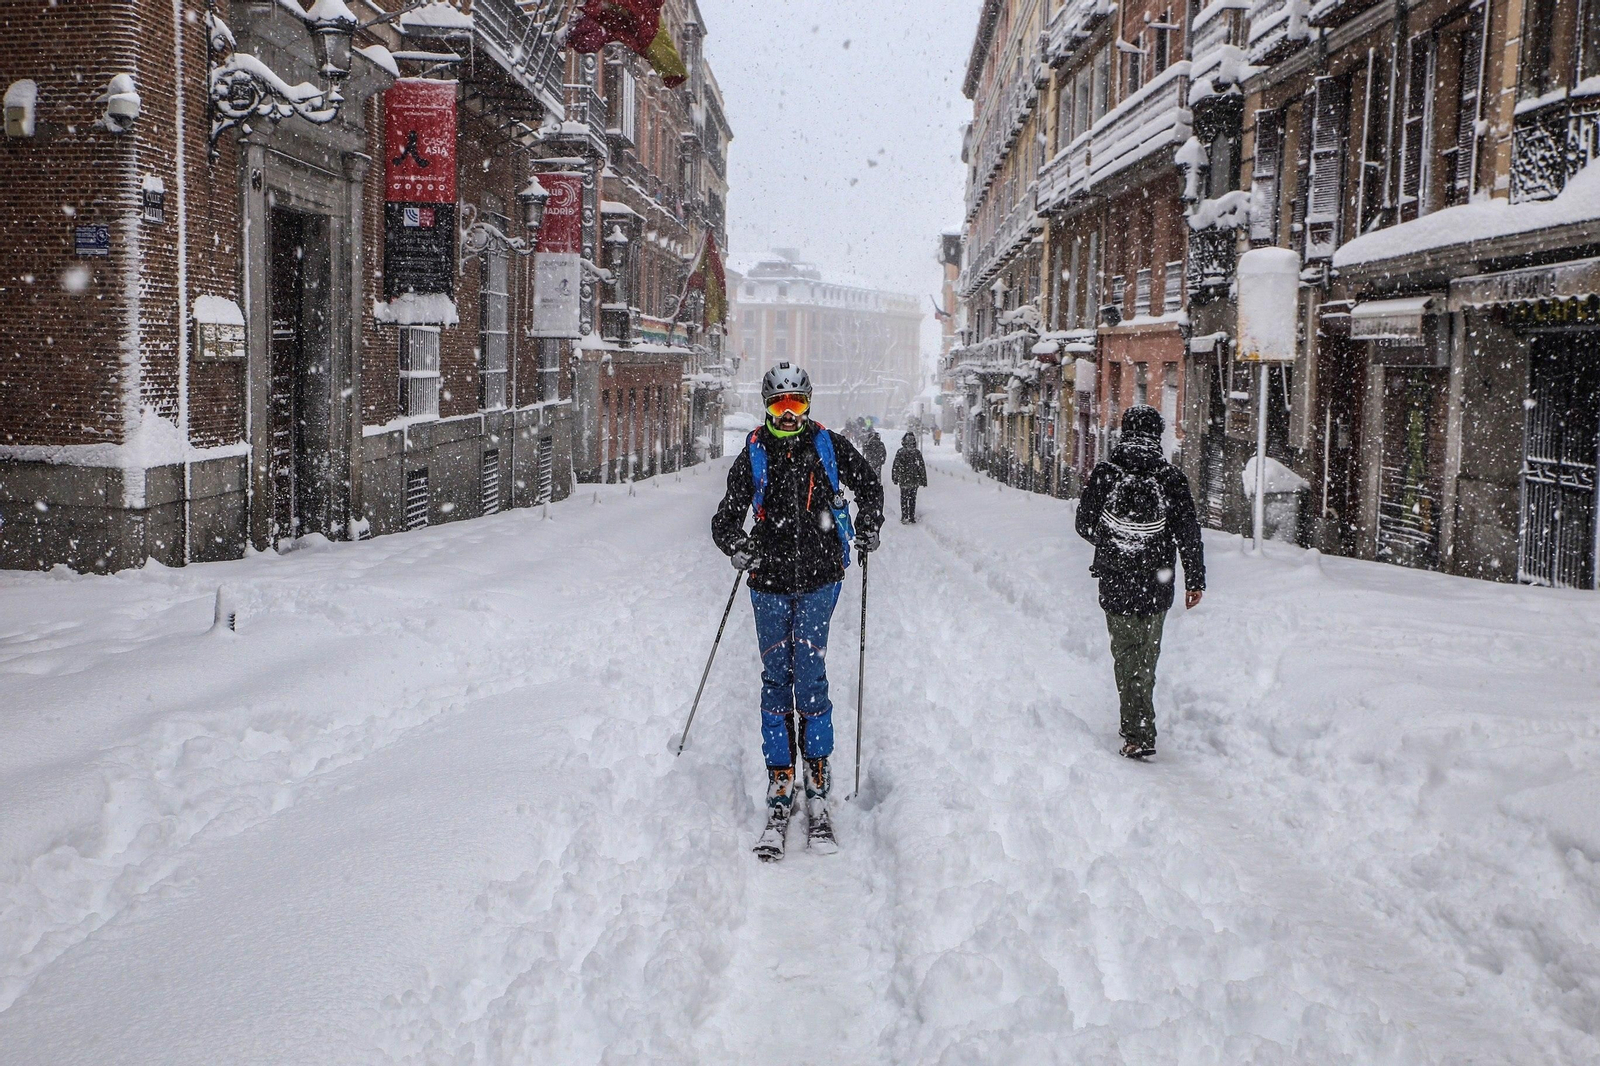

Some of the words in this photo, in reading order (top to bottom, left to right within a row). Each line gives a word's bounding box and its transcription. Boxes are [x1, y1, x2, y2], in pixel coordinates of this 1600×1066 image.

[422, 137, 448, 146] CASA
[425, 146, 448, 155] ASIA
[546, 187, 563, 196] LUB
